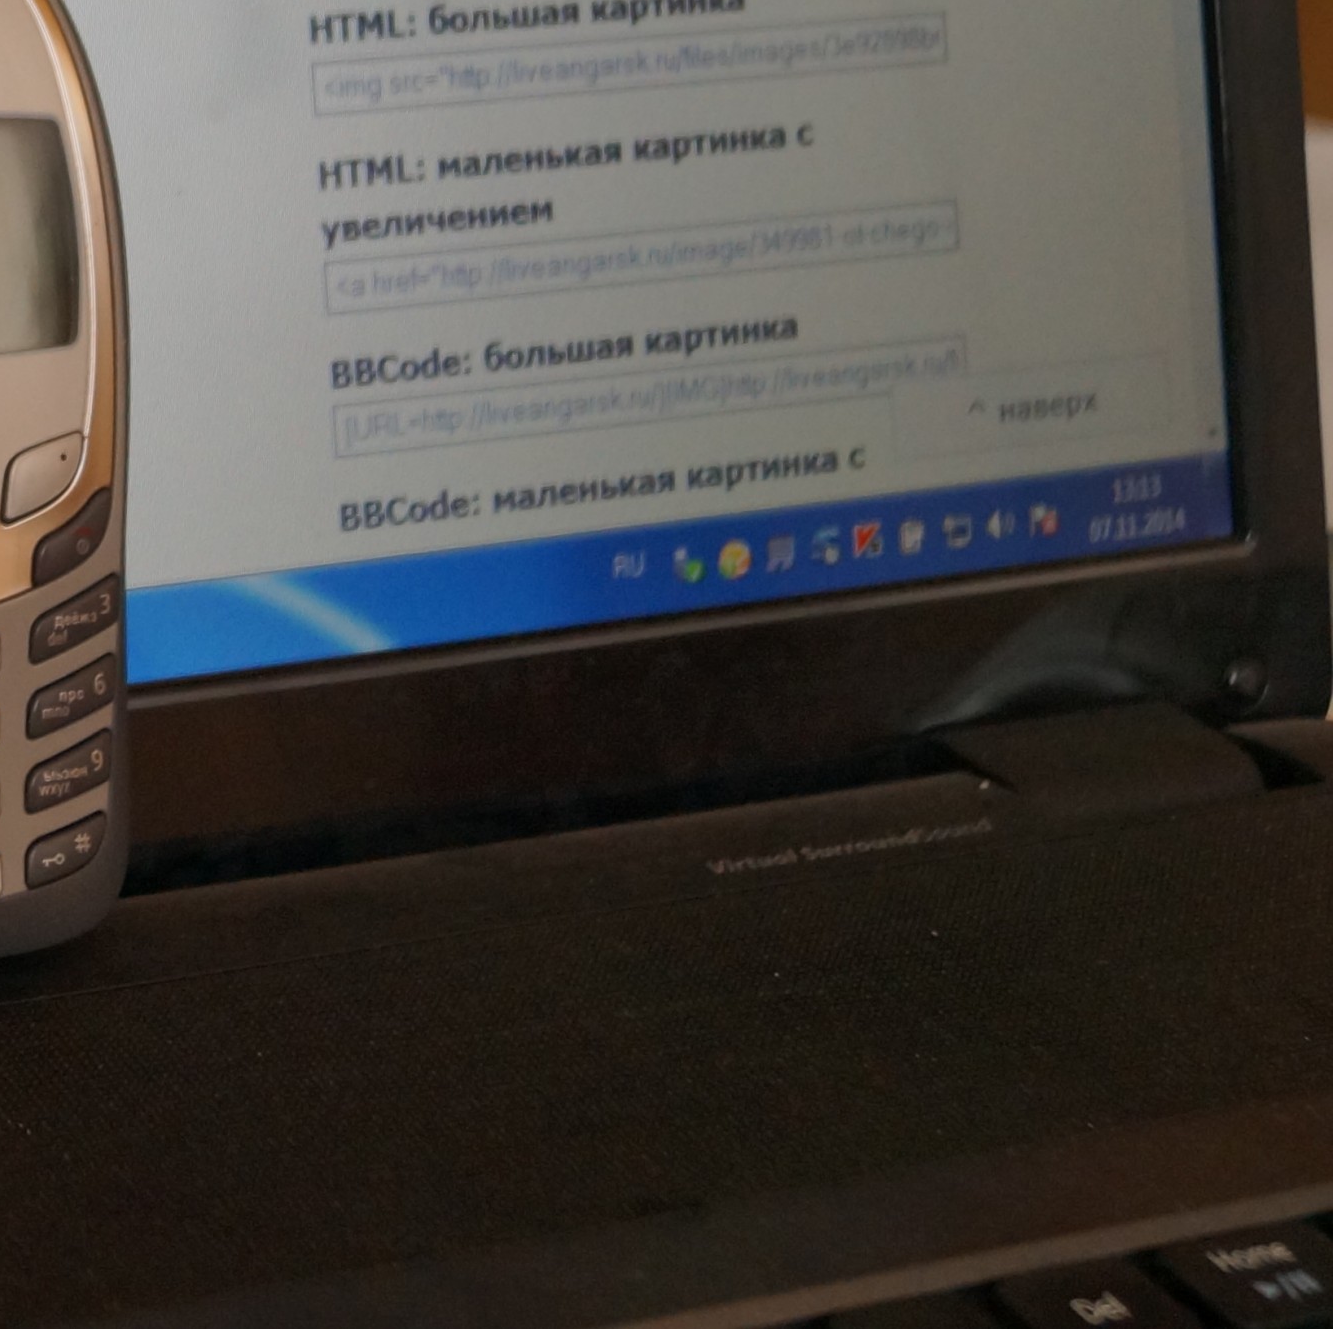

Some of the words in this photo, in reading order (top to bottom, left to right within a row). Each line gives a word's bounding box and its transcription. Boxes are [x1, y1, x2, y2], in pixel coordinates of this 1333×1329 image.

[308, 8, 418, 45] HTML:
[428, 0, 580, 37] большая
[318, 156, 427, 192] HTML:
[437, 141, 622, 181] маленькая
[633, 126, 787, 166] картинка
[796, 122, 815, 147] с
[321, 197, 555, 249] увеличением
[330, 344, 473, 391] BBCode:
[483, 332, 635, 377] большая
[644, 313, 800, 360] картинка
[997, 388, 1099, 425] наверх
[339, 487, 483, 533] BBCode:
[492, 469, 676, 517] маленькая
[686, 447, 840, 494] картинка
[848, 445, 867, 472] с
[611, 550, 647, 580] RU
[99, 594, 111, 615] 3
[93, 671, 107, 696] 6
[90, 749, 104, 772] 9
